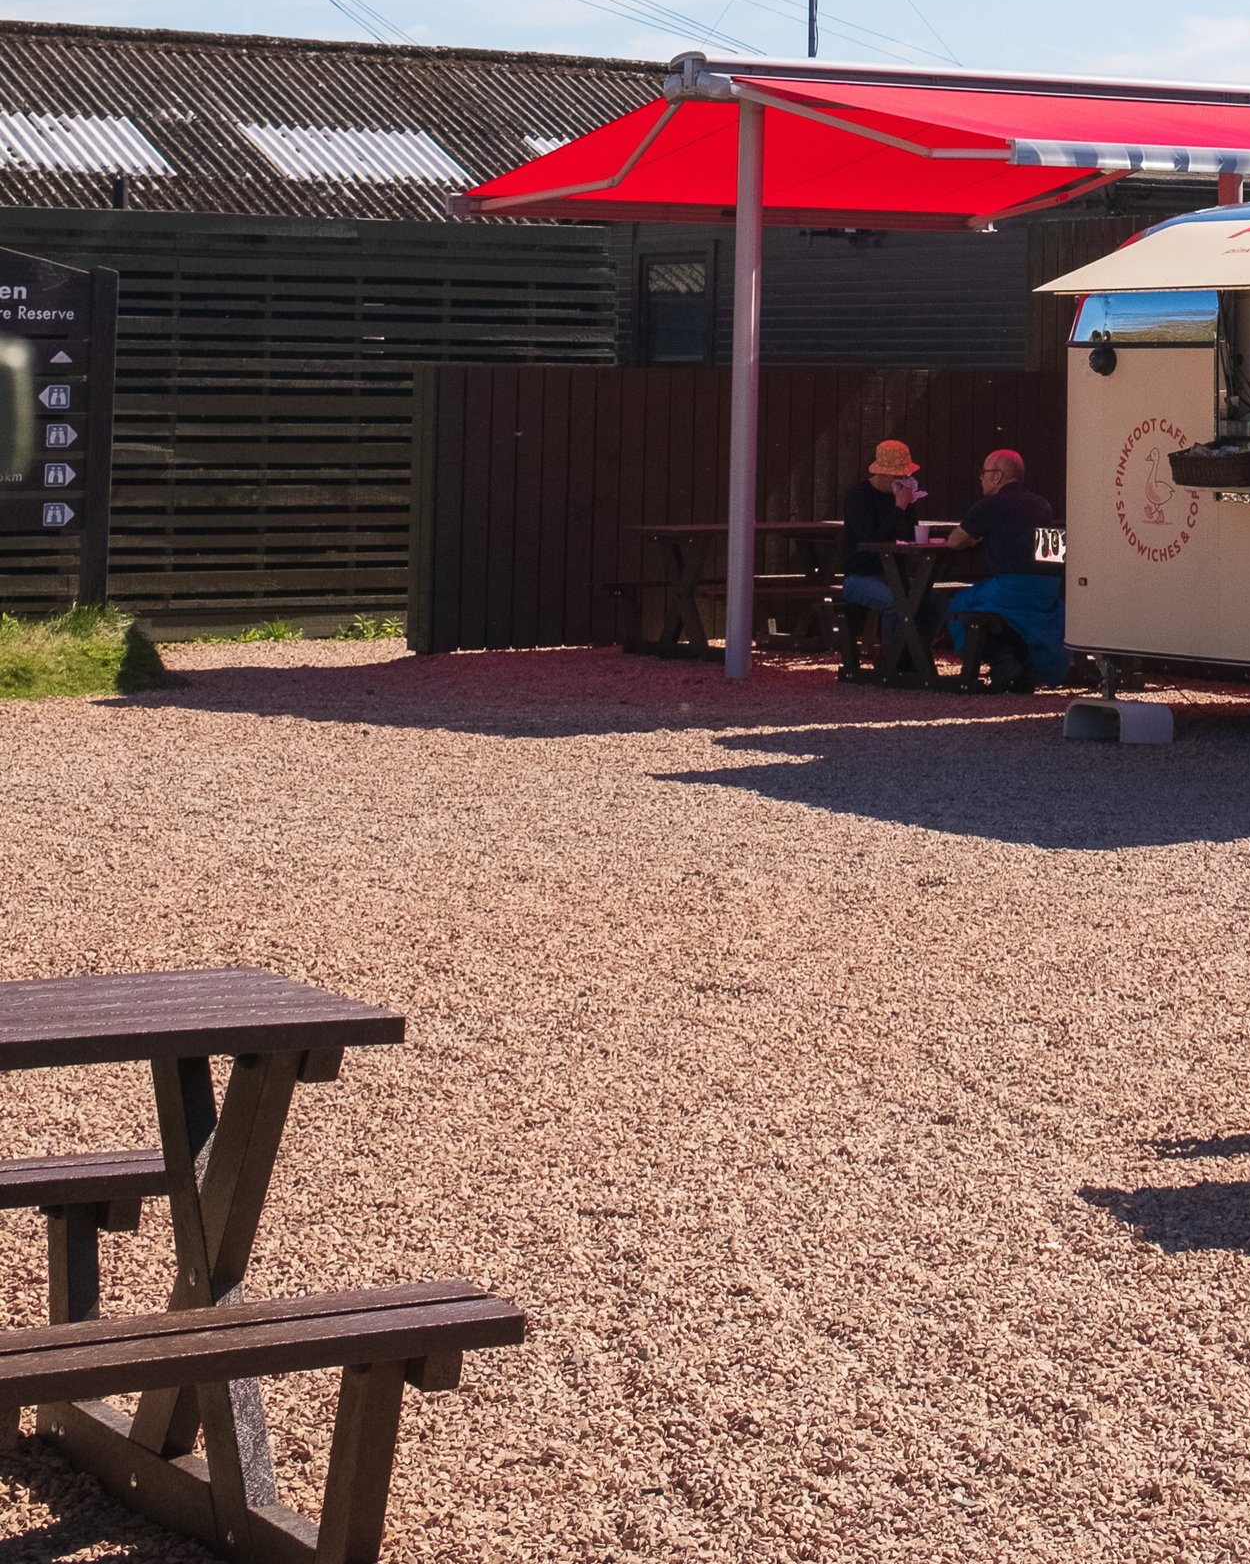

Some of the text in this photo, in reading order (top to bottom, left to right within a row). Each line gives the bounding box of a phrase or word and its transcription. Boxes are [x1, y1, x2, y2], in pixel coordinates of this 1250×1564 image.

[18, 305, 75, 320] Reserve
[1115, 418, 1188, 487] PINKFOOT CAFE
[1115, 499, 1182, 563] SANDWICHES
[1180, 531, 1190, 544] &
